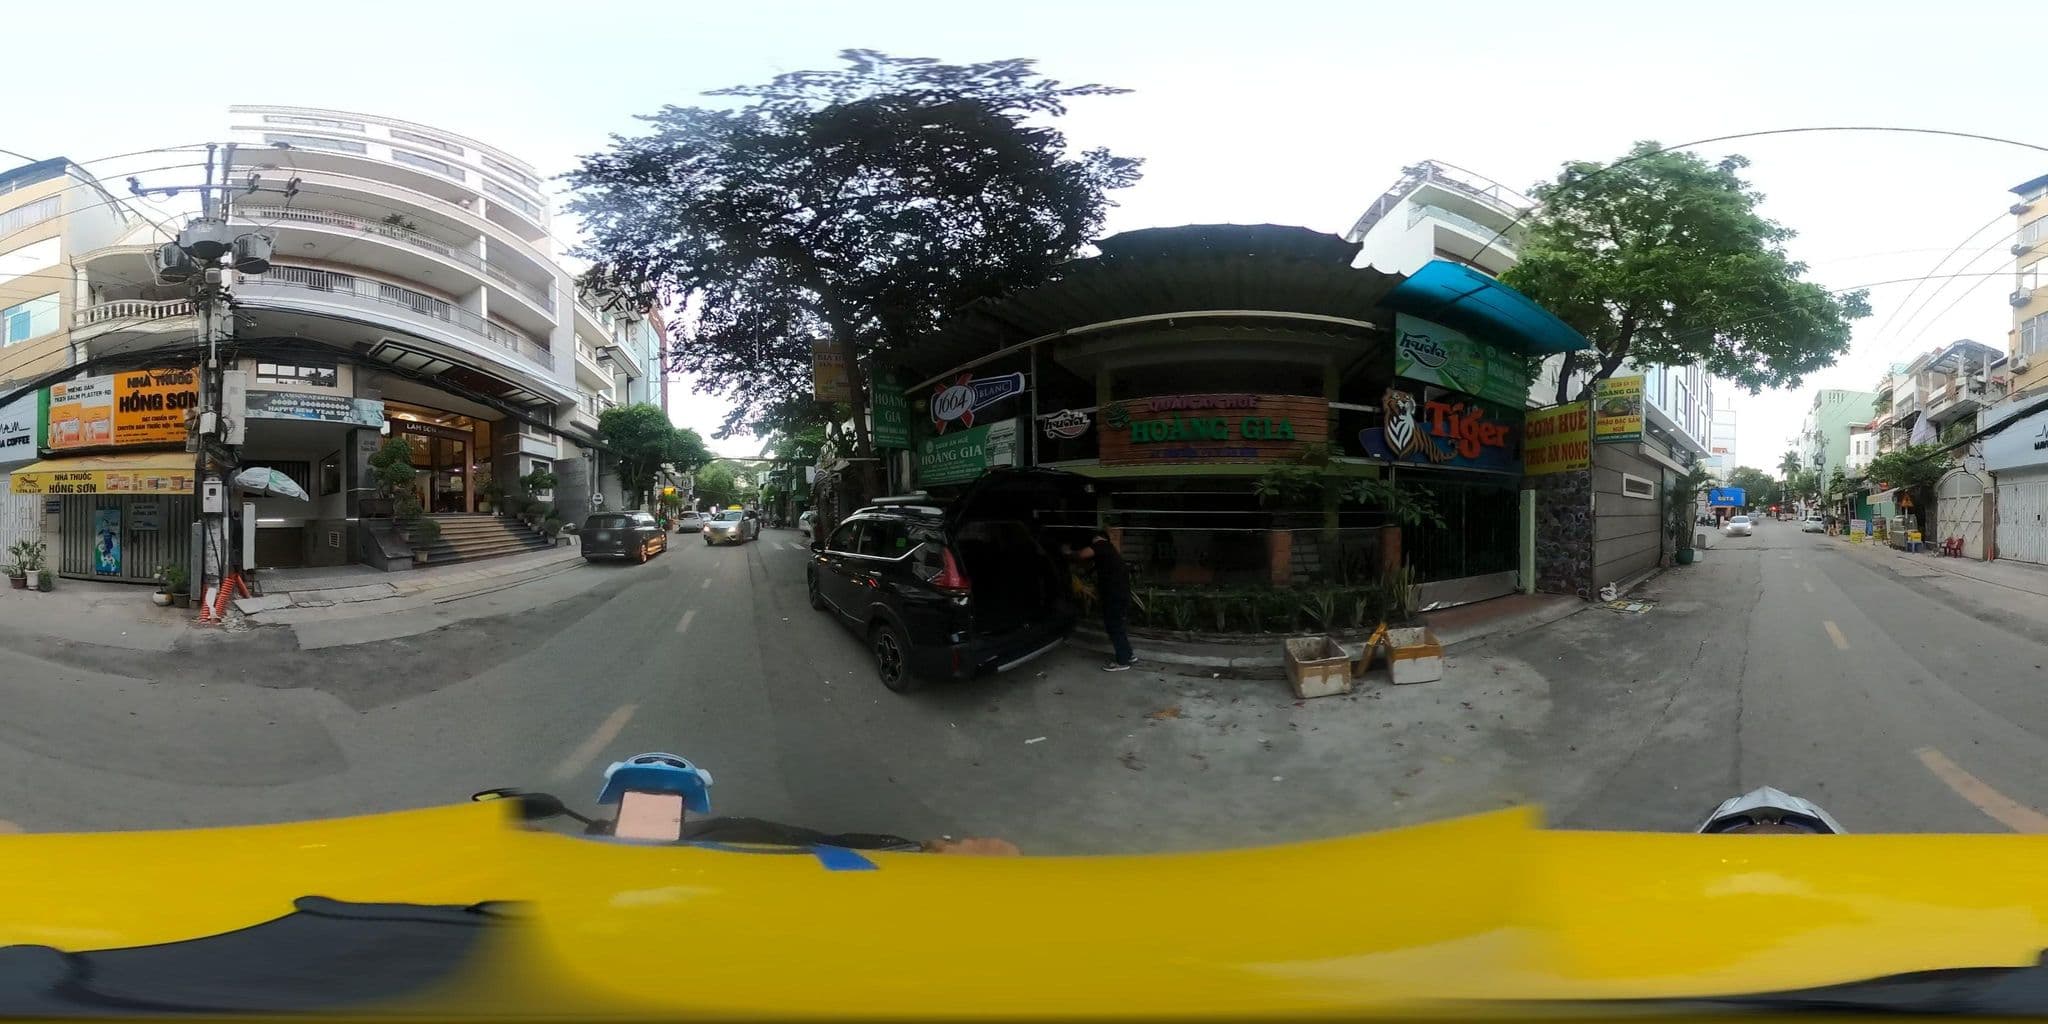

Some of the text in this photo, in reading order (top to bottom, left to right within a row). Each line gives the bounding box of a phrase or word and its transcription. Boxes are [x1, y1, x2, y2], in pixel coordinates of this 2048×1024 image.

[979, 383, 1009, 398] BLANC
[119, 389, 163, 413] HỒNG
[938, 389, 967, 415] 1664
[885, 410, 901, 423] GIA
[1130, 411, 1295, 443] HOÀNG GIA
[1424, 400, 1510, 459] Tiger
[6, 435, 30, 447] COFFEE
[960, 444, 983, 458] GIA
[70, 472, 92, 480] THUỐC
[49, 482, 73, 493] HỒNG
[76, 483, 96, 493] SƠN
